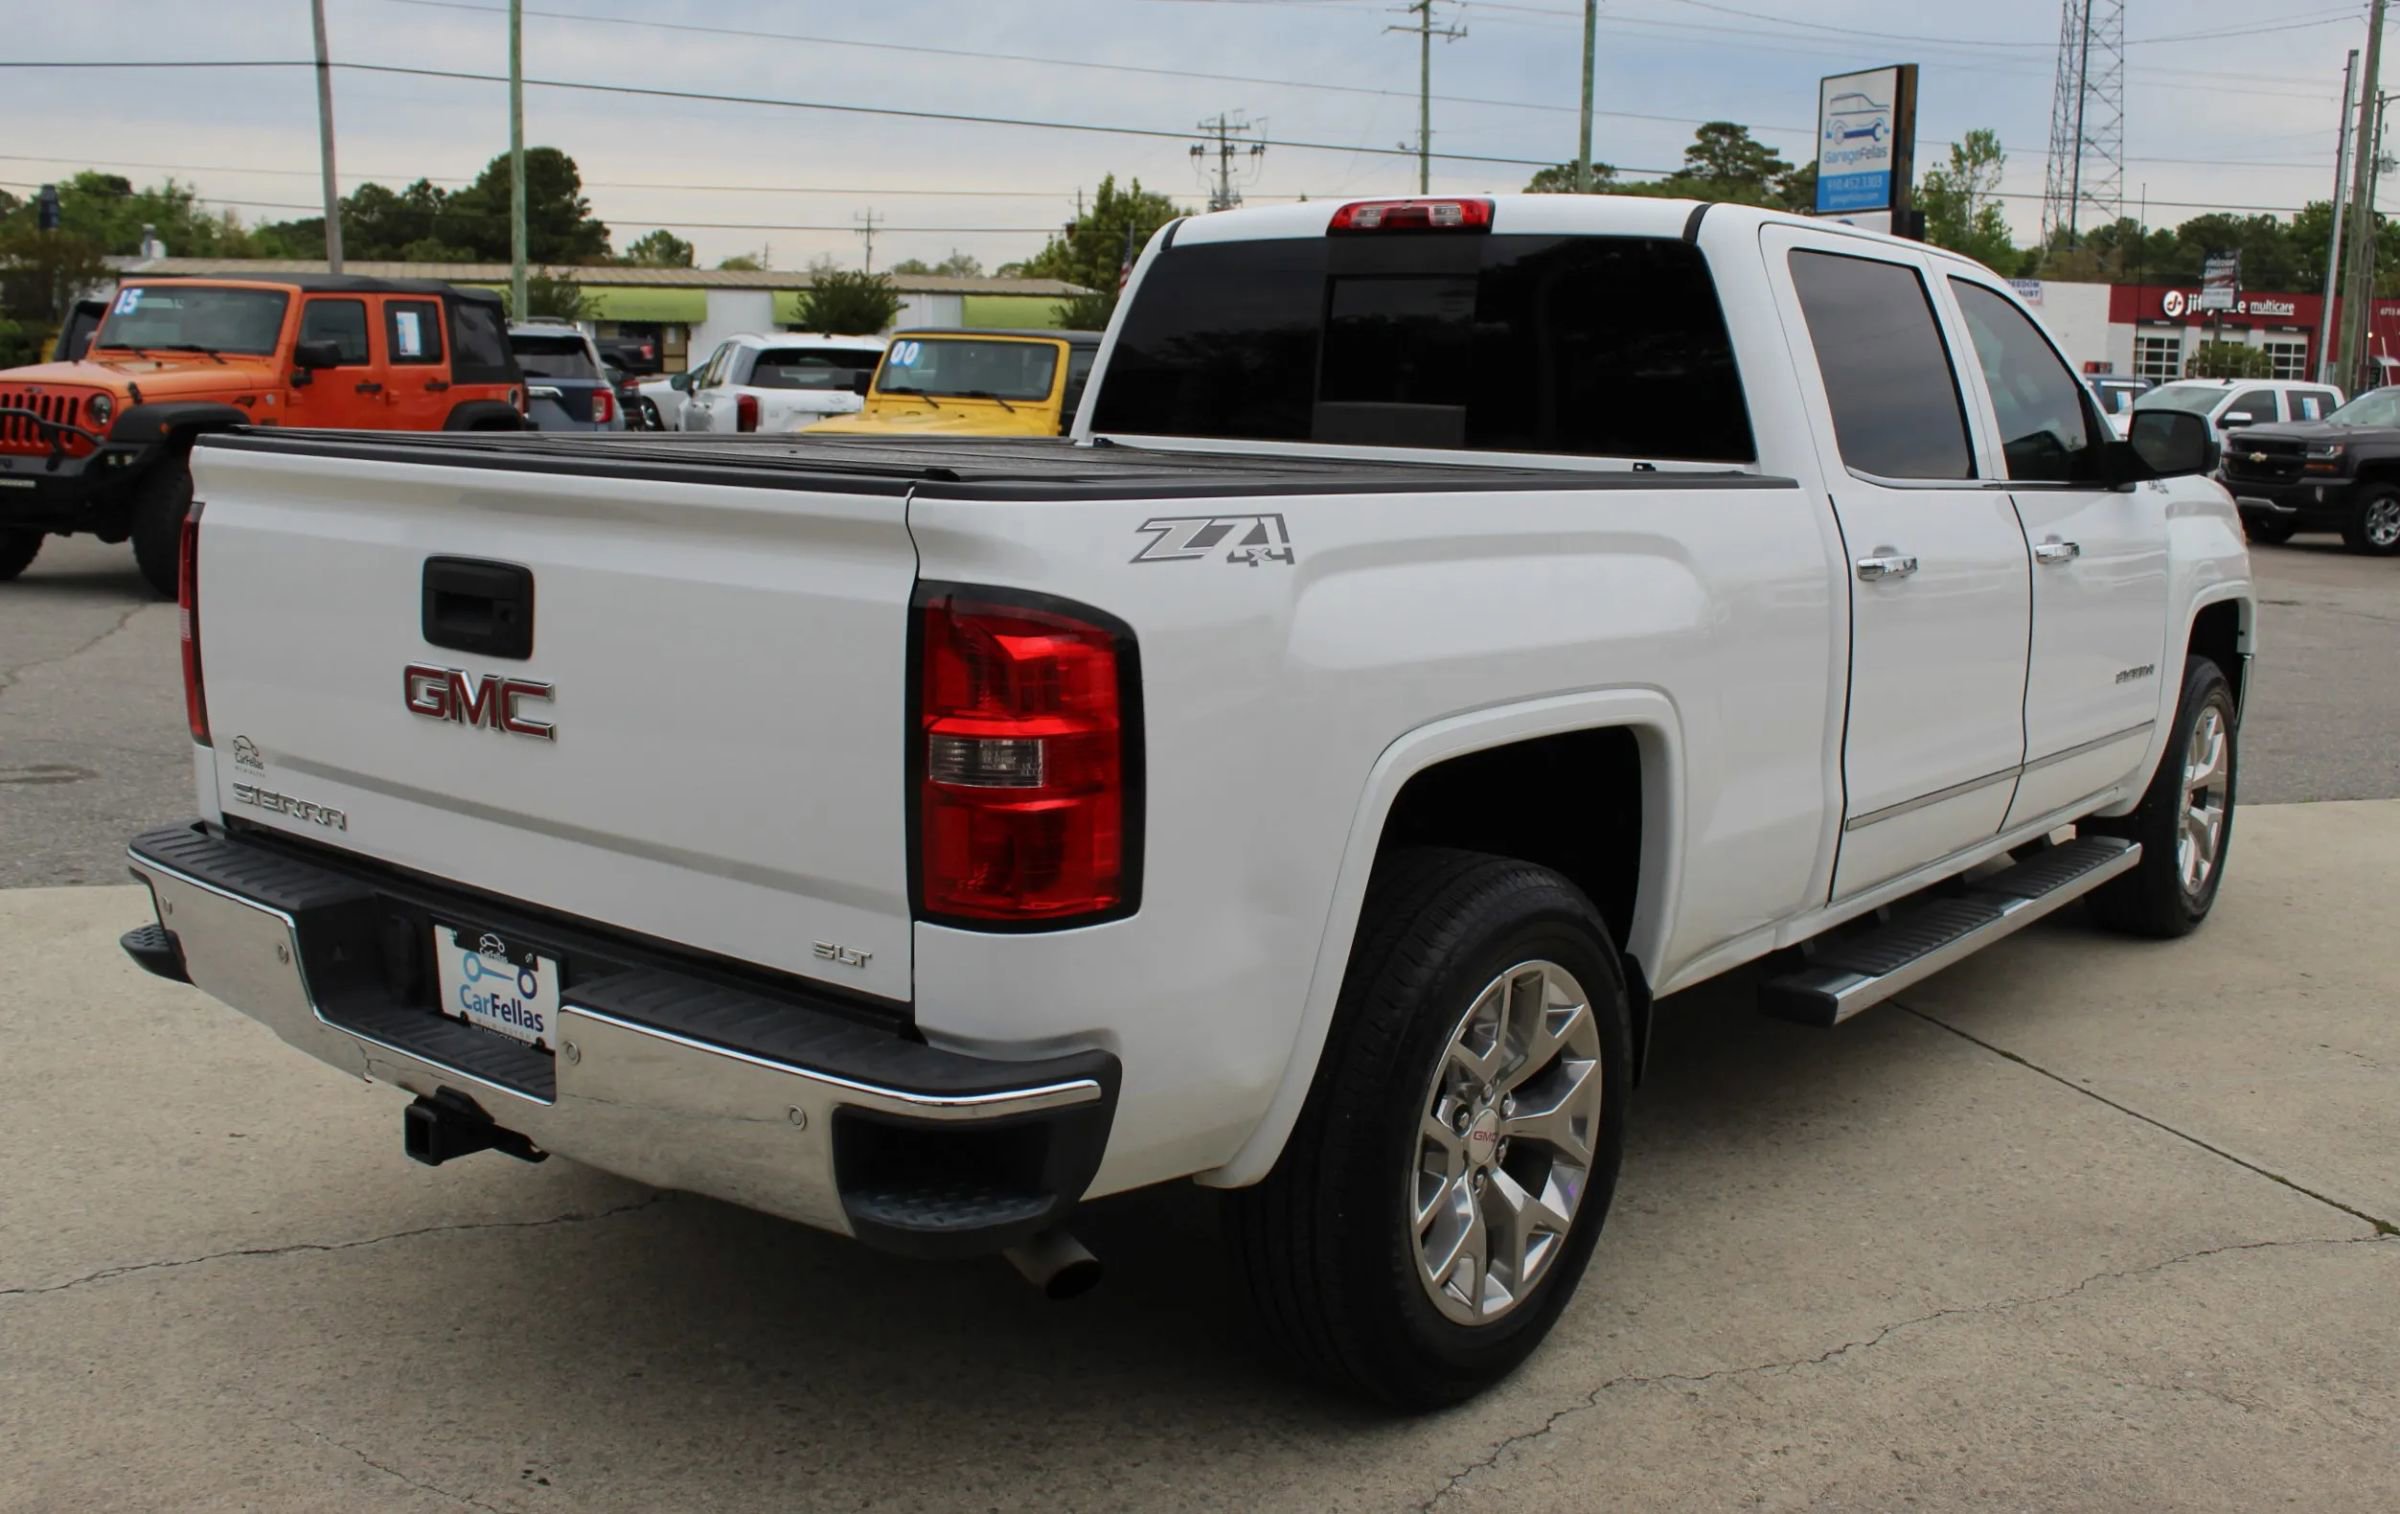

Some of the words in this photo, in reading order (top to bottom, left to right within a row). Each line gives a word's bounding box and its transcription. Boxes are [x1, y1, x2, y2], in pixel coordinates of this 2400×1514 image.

[114, 288, 144, 315] 15
[2250, 300, 2295, 313] multicare
[889, 340, 920, 366] 00
[403, 660, 557, 743] GMC
[232, 781, 348, 831] SIERRA
[813, 939, 873, 968] SLT
[459, 983, 544, 1033] CarFellas
